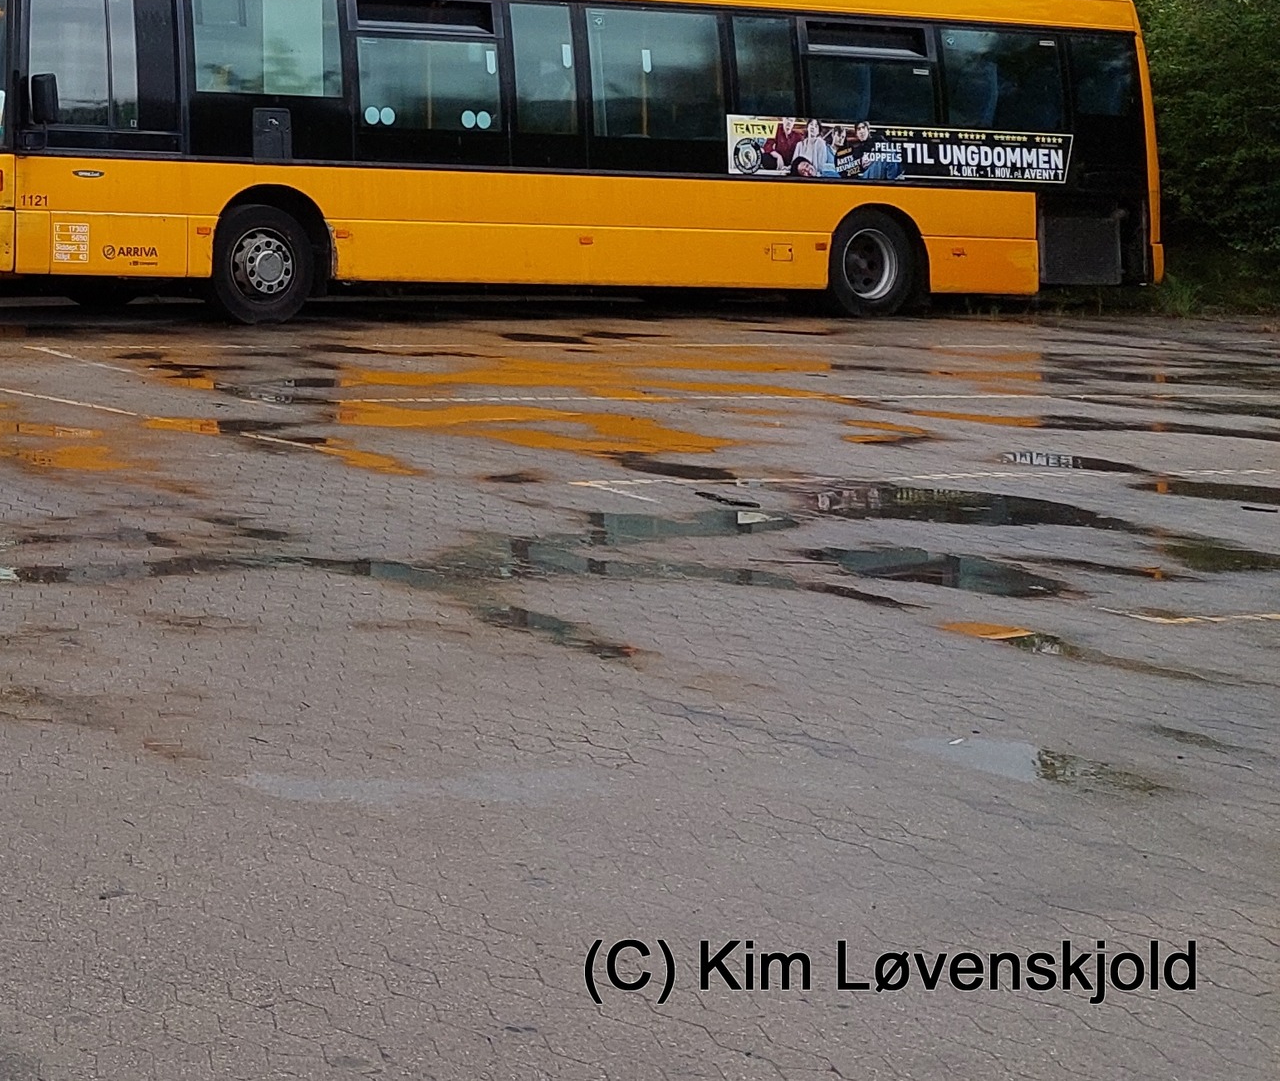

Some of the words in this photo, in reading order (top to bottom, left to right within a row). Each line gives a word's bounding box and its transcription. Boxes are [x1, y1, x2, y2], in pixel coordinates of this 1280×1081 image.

[903, 143, 935, 164] TIL
[939, 144, 1064, 170] UNGDOMMEN
[1024, 169, 1055, 180] AVENY
[20, 194, 48, 207] 1121
[117, 247, 158, 258] ARRIVA
